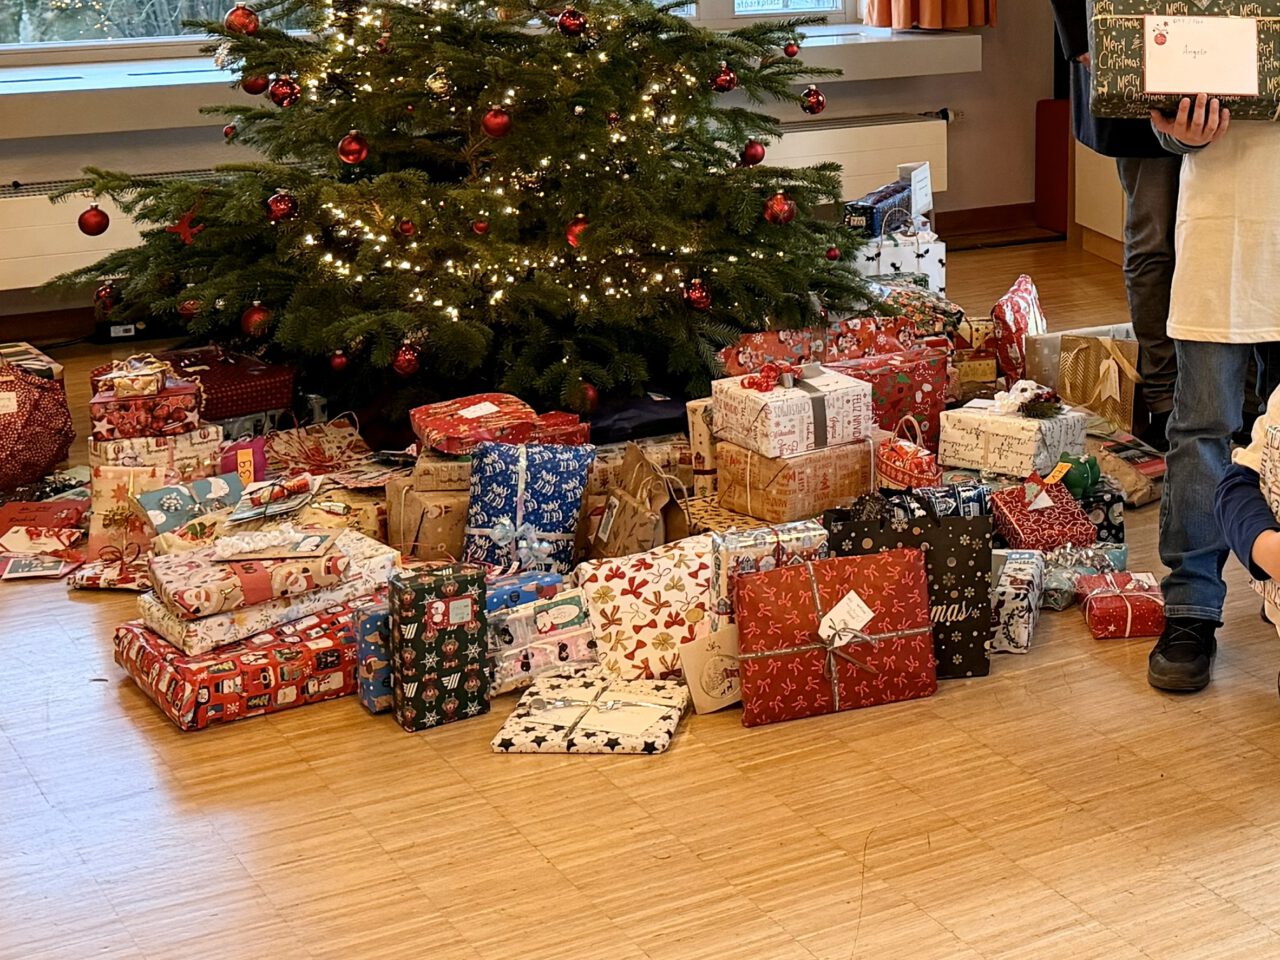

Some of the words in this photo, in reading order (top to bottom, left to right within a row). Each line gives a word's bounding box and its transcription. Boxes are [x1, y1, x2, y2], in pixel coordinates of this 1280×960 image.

[1093, 0, 1114, 15] Merry
[1166, 1, 1188, 16] Merry
[1240, 3, 1261, 17] Merry
[1103, 34, 1125, 52] Merry
[1258, 40, 1274, 57] erry
[1098, 50, 1140, 69] Christmas
[1118, 74, 1140, 92] Merry
